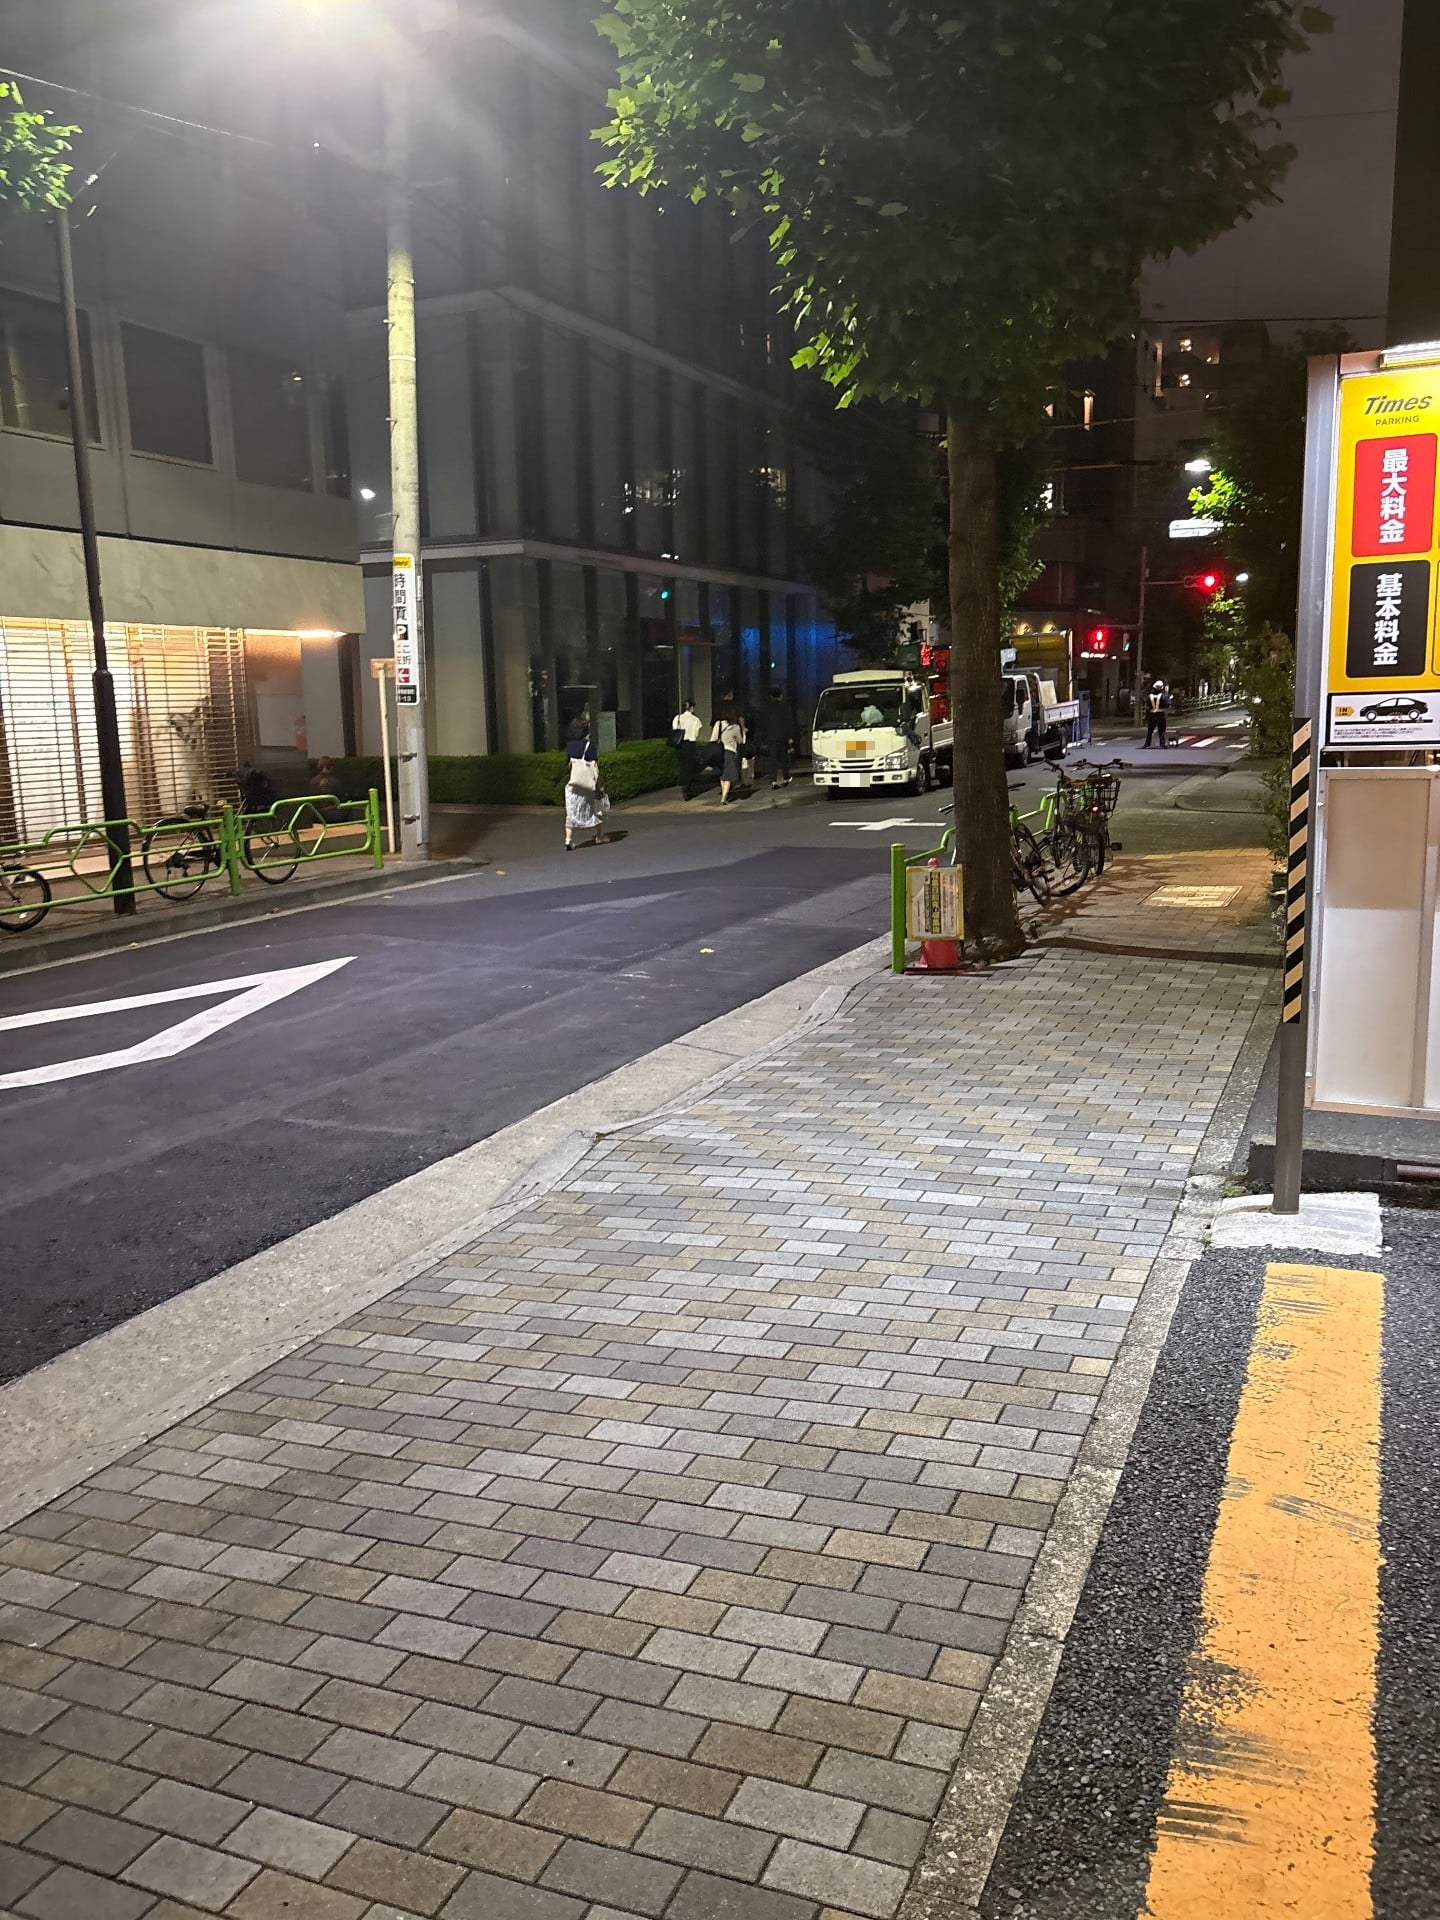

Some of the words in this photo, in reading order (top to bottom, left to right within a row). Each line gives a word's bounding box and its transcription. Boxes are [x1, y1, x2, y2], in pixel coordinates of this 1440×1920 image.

[1364, 395, 1433, 415] Times
[1375, 415, 1420, 426] PARKING
[1379, 447, 1408, 544] 最大料金
[1373, 572, 1402, 666] 基本料金
